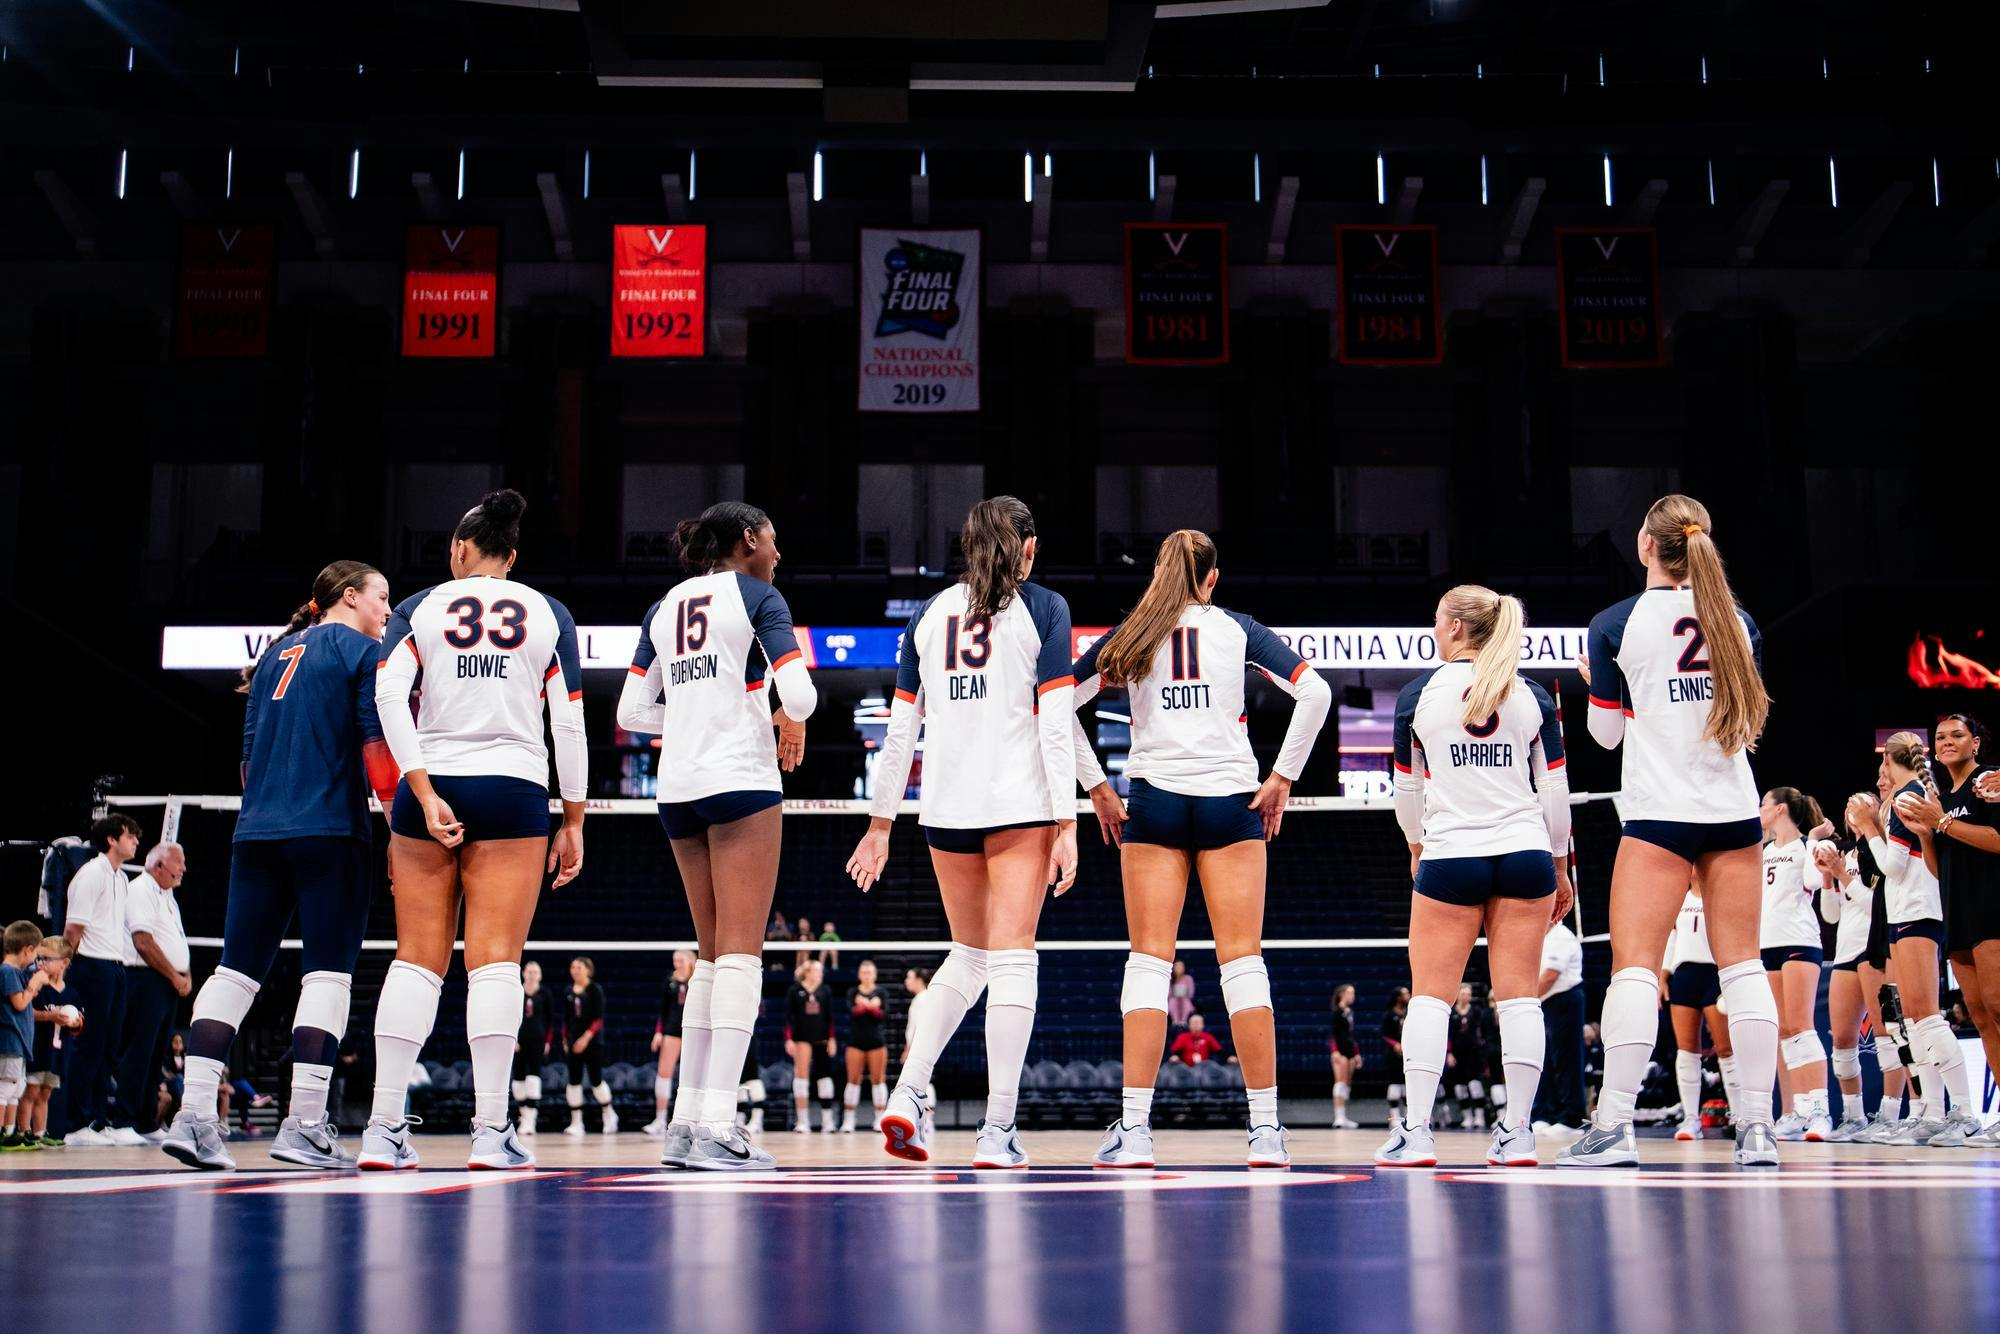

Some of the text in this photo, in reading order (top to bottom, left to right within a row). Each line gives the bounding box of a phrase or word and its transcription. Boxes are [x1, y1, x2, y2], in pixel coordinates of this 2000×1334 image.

[647, 229, 673, 253] V
[892, 270, 953, 289] FINAL
[412, 289, 489, 301] FINAL FOUR
[620, 289, 697, 301] FINAL FOUR
[887, 291, 951, 311] FOUR
[1138, 291, 1215, 303] FINAL FOUR
[1352, 292, 1426, 304] FINAL FOUR
[1572, 295, 1648, 306] FINAL FOUR
[418, 312, 480, 339] 1991
[626, 312, 691, 339] 1992
[1144, 312, 1210, 344] 1981
[1356, 312, 1424, 344] 1984
[1576, 317, 1648, 346] 2019
[874, 347, 965, 361] NATIONAL
[864, 363, 974, 378] CHAMPIONS
[893, 384, 945, 404] 2019
[443, 596, 528, 650] 33
[676, 595, 713, 656] 15
[945, 615, 993, 671] 13
[1171, 627, 1200, 681] 11
[1279, 635, 1386, 661] GINIA
[1673, 616, 1712, 673] 2
[272, 644, 306, 700] 7
[457, 655, 510, 679] BOWIE
[670, 655, 718, 686] ROBINSON
[950, 674, 987, 701] DEAN
[1162, 684, 1211, 710] SCOTT
[1668, 677, 1713, 703] ENNIS
[1450, 743, 1512, 767] BARRIER
[1767, 866, 1776, 885] 5
